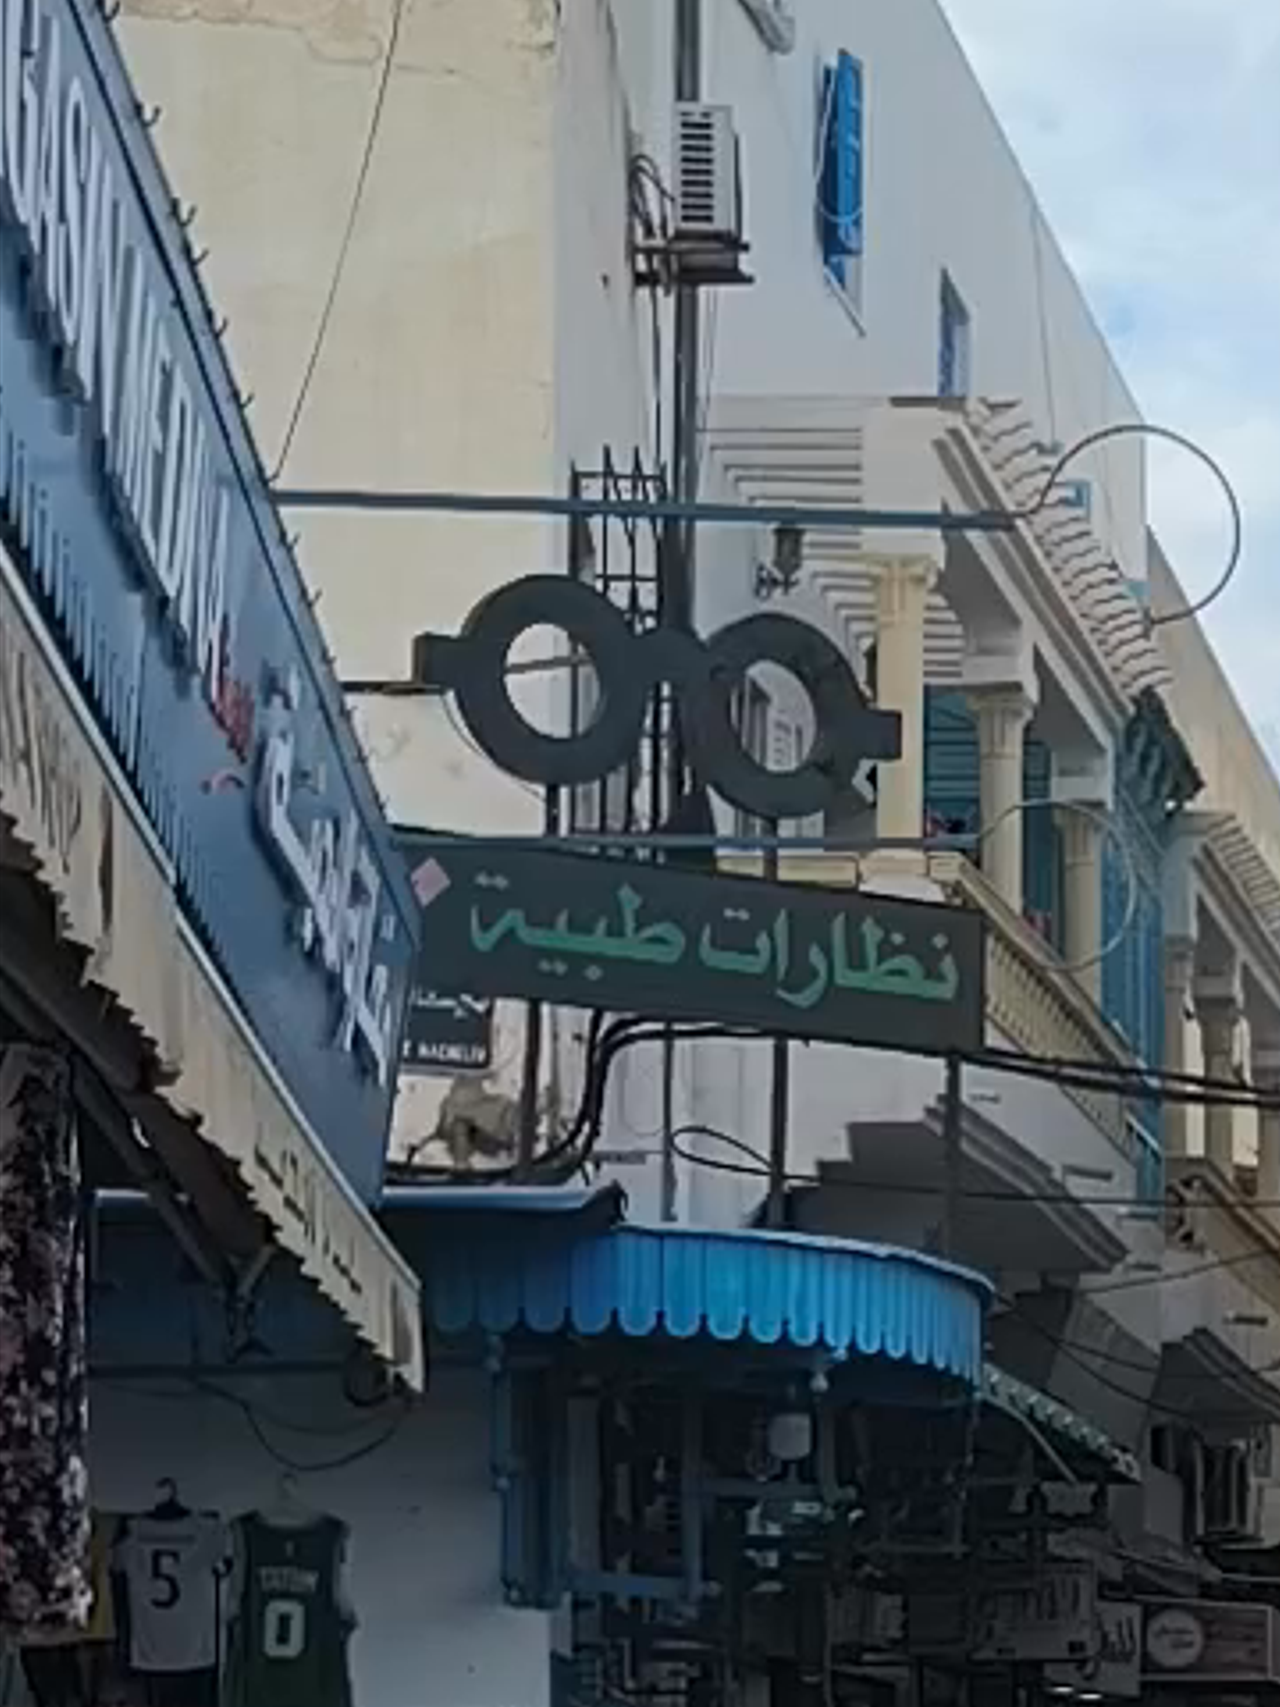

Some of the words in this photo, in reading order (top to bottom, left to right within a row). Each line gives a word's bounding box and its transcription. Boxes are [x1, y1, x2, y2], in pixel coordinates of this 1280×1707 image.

[470, 870, 686, 981] طبية
[698, 906, 962, 1009] نظارات
[150, 1549, 181, 1610] 5
[263, 1598, 306, 1660] 0
